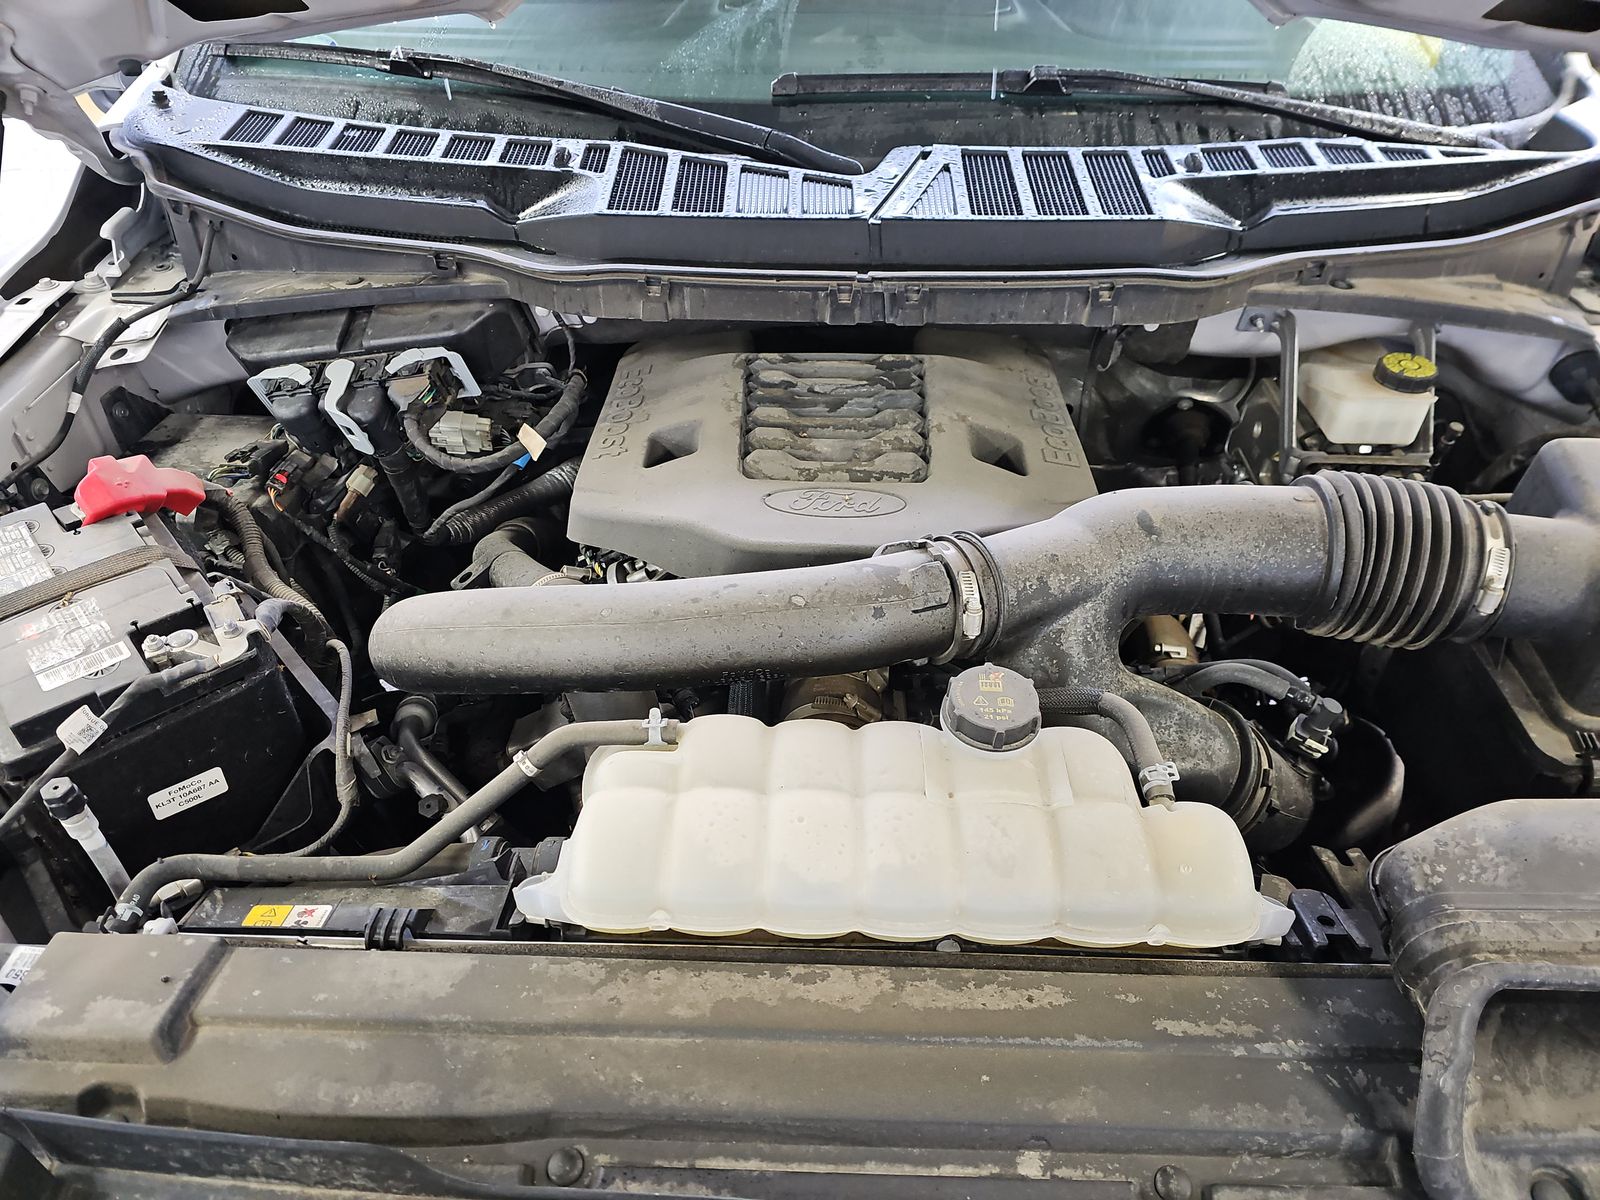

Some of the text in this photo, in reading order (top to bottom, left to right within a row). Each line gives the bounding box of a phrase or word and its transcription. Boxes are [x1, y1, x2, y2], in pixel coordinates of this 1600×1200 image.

[788, 490, 882, 513] Ford
[155, 778, 220, 809] KL3T 10A687 AA
[168, 779, 202, 796] FoMoCo
[178, 794, 203, 807] C500L
